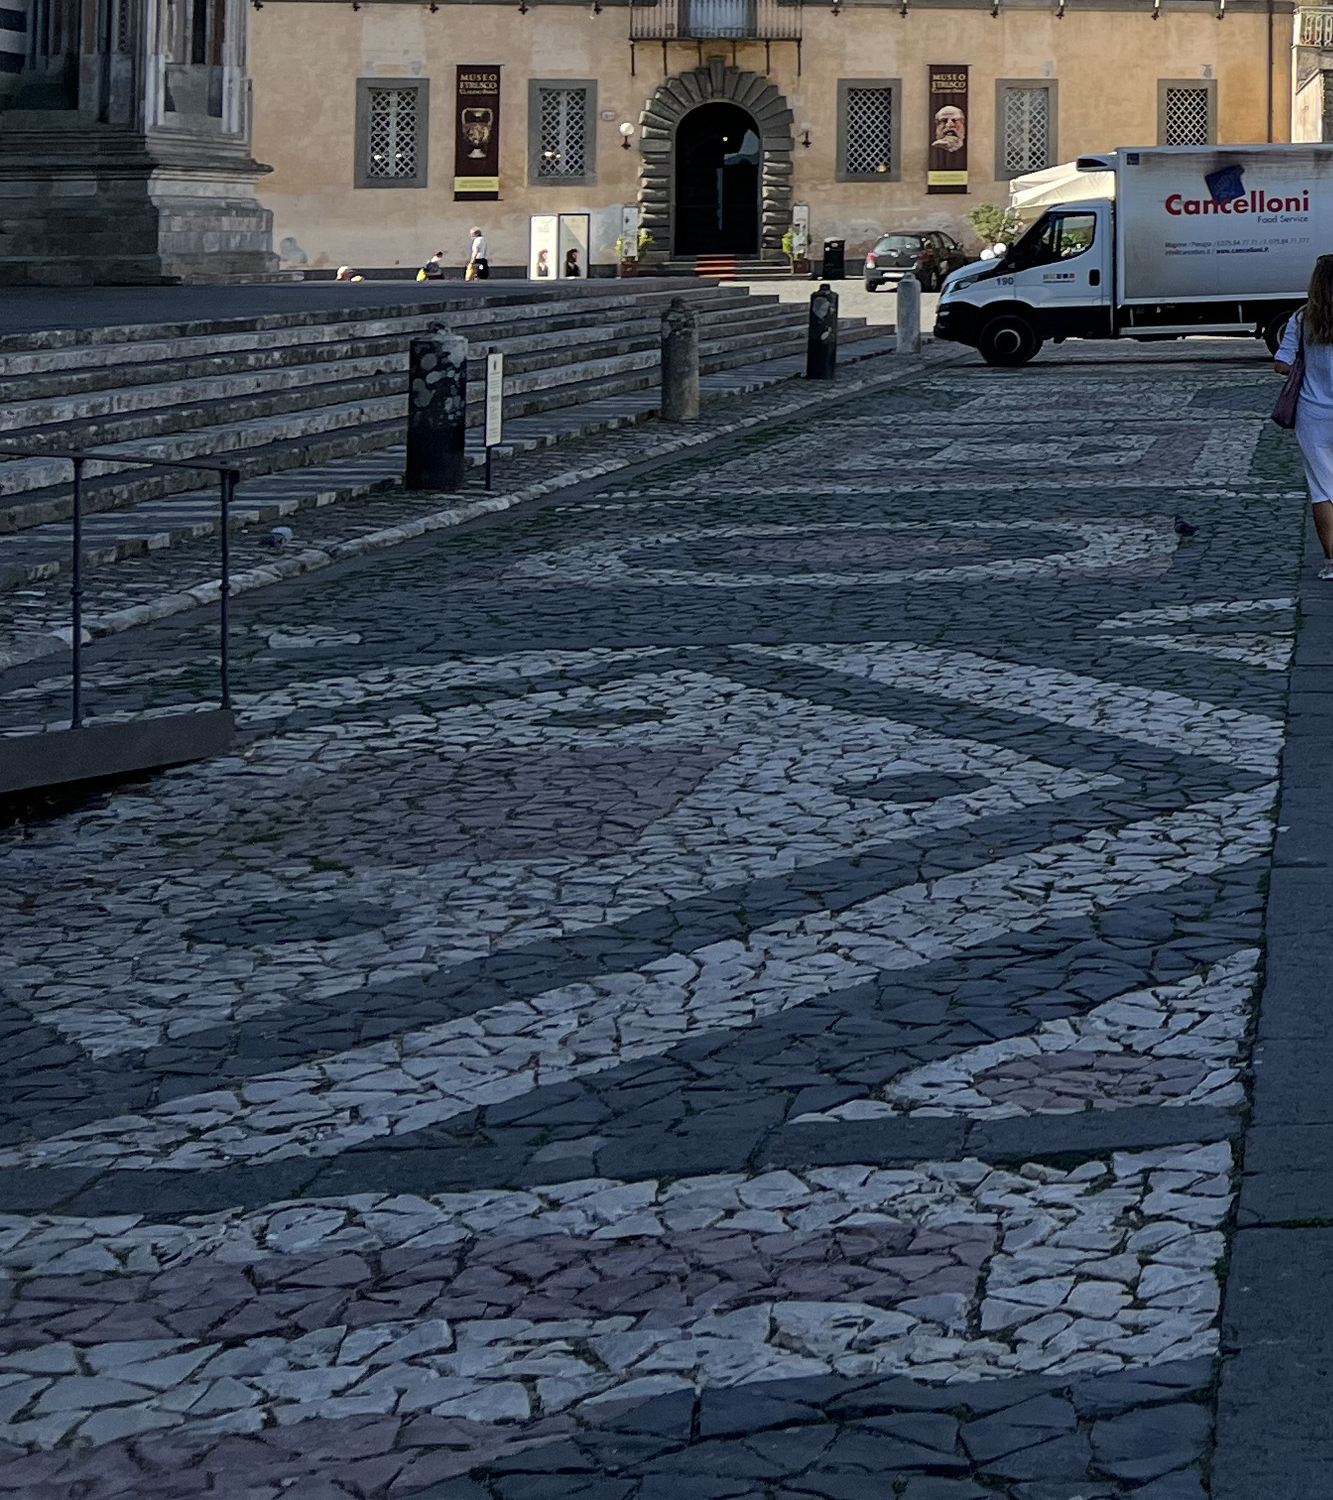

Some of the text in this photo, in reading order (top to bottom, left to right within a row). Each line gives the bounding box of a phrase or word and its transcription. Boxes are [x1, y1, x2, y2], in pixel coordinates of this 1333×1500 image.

[1165, 189, 1309, 215] Cancelloni
[1257, 215, 1309, 224] Food Service
[996, 277, 1014, 286] 190
